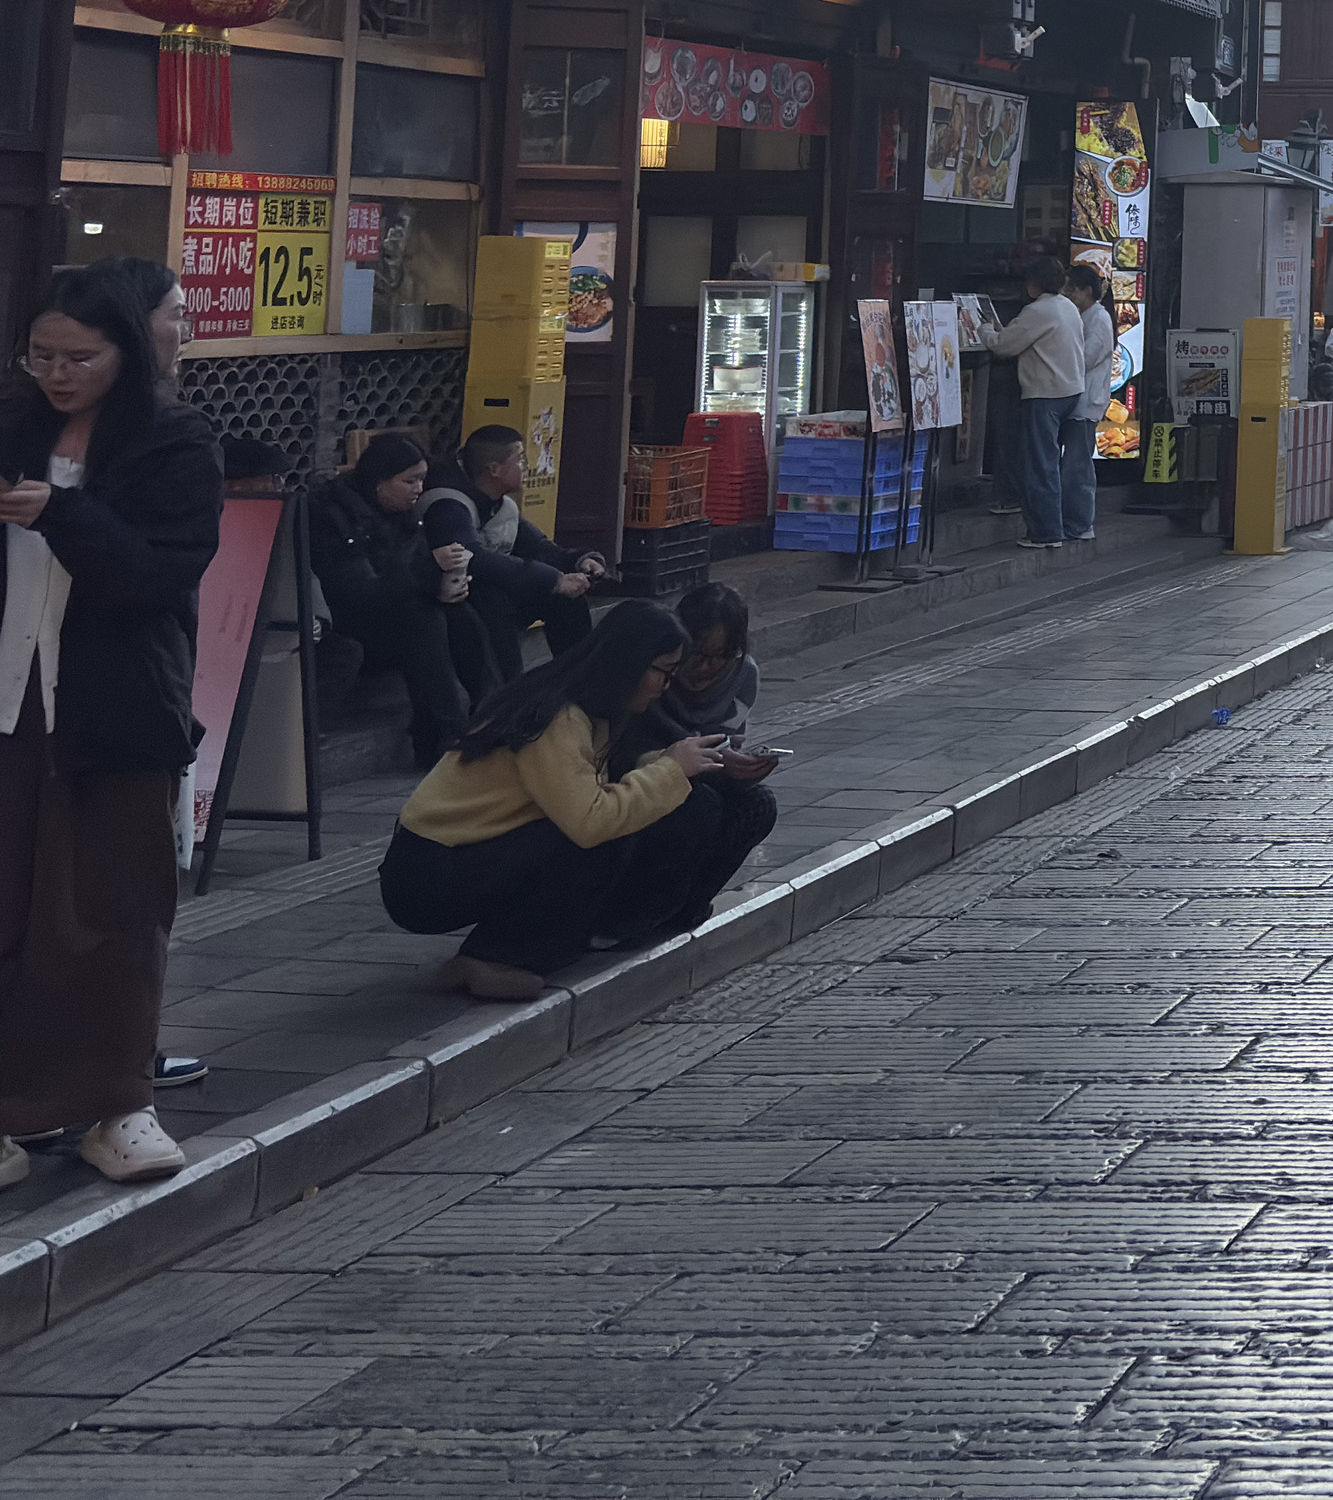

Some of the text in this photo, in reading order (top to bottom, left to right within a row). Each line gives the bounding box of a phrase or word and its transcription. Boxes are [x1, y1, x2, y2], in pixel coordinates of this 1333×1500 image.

[187, 195, 254, 226] 长期岗位
[263, 198, 327, 227] 短期兼职
[182, 236, 254, 275] 煮品/小吃
[347, 234, 379, 255] 小时工
[259, 246, 313, 307] 12.5
